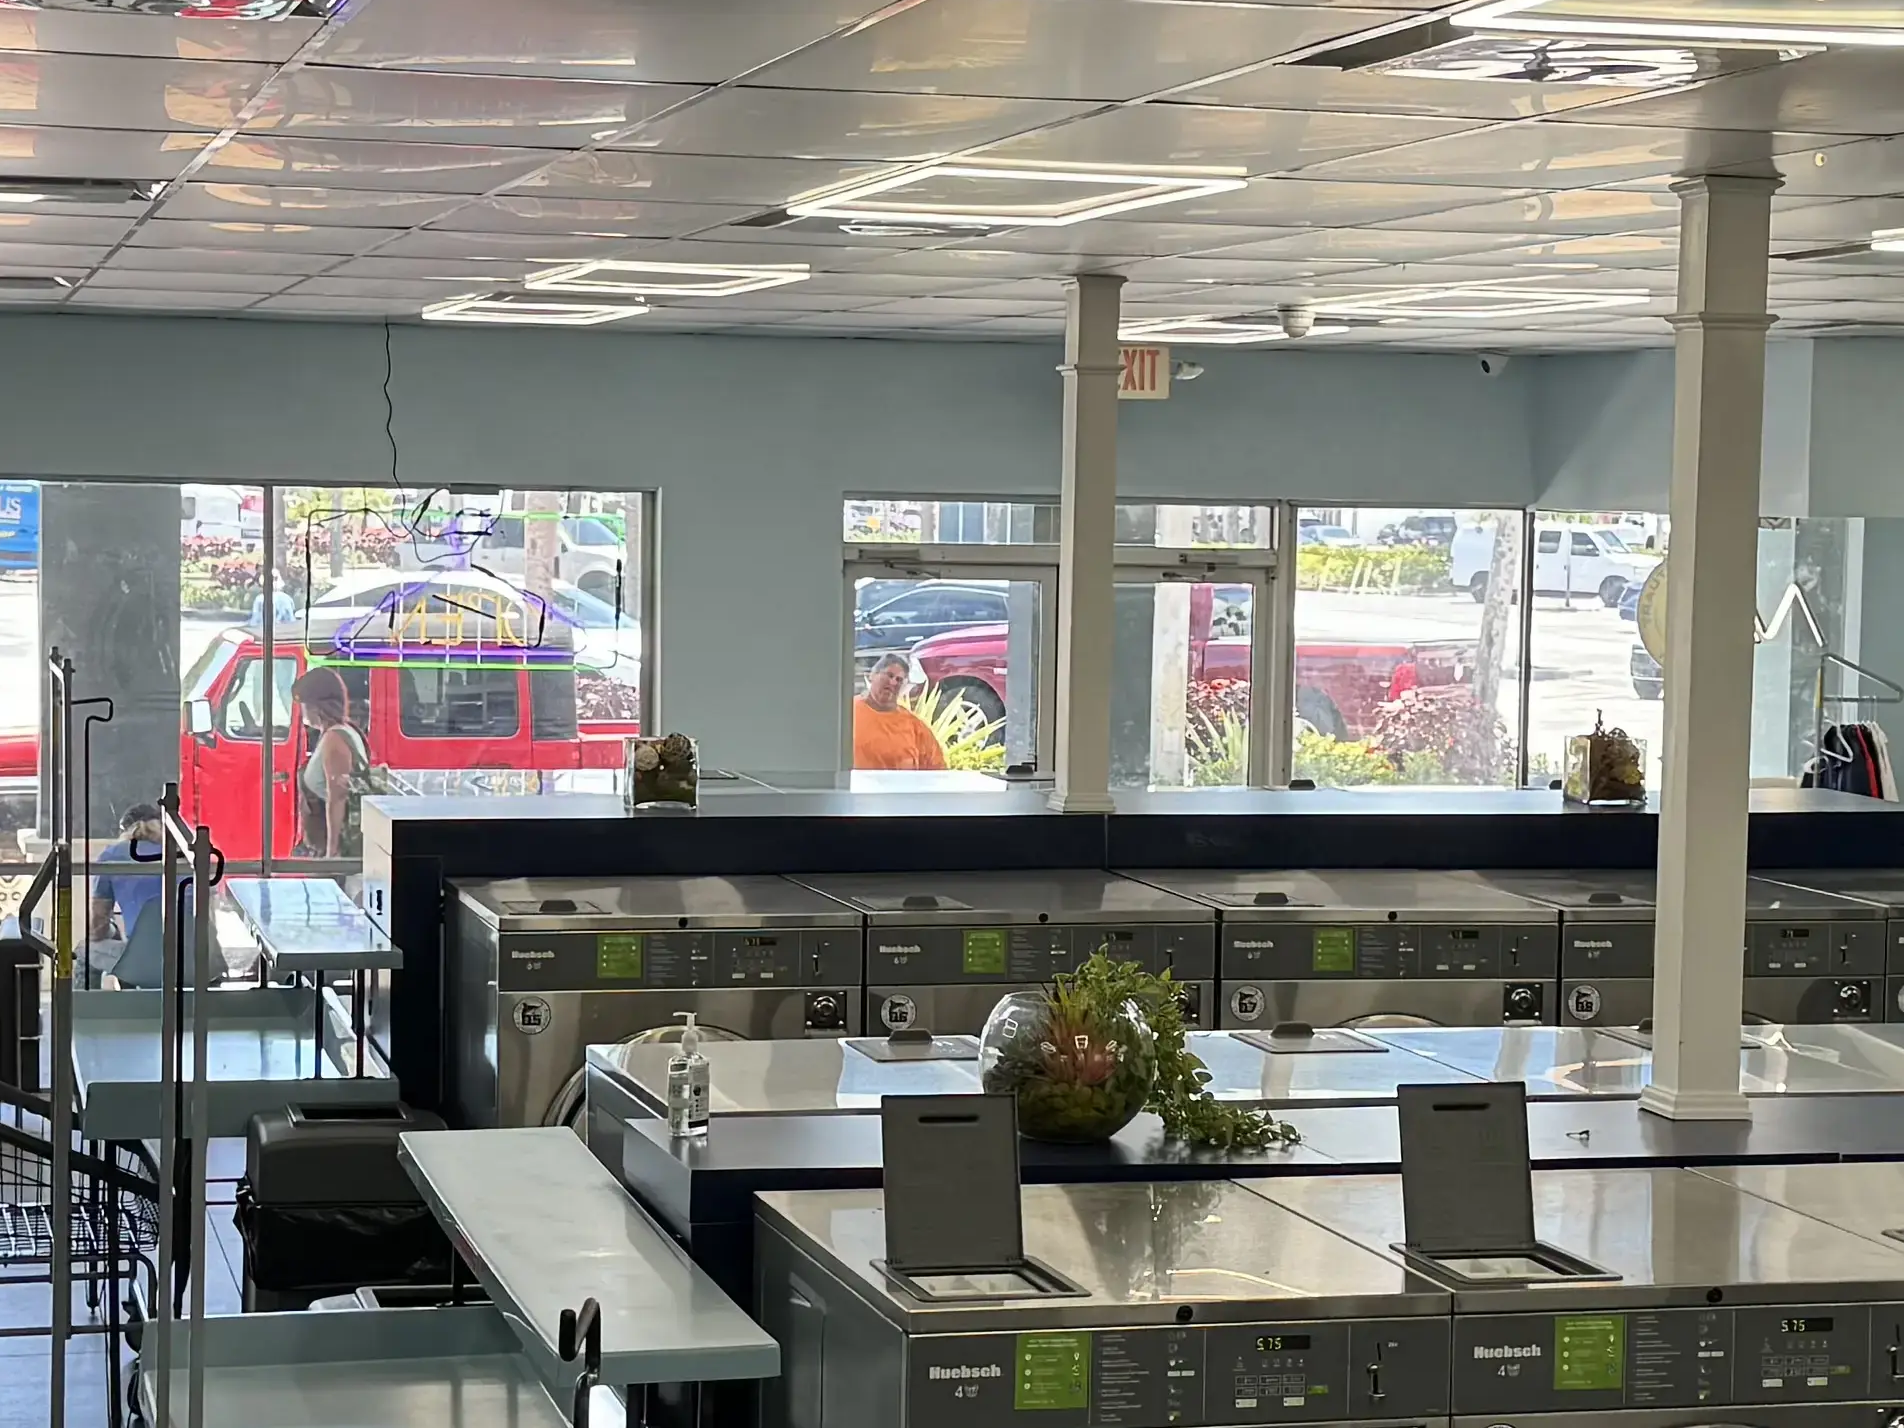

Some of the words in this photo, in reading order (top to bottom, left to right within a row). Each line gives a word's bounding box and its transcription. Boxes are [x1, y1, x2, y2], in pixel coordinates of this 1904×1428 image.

[1119, 349, 1160, 391] XIT
[1473, 1344, 1542, 1359] Huebsch
[929, 1364, 1001, 1380] Huebsch
